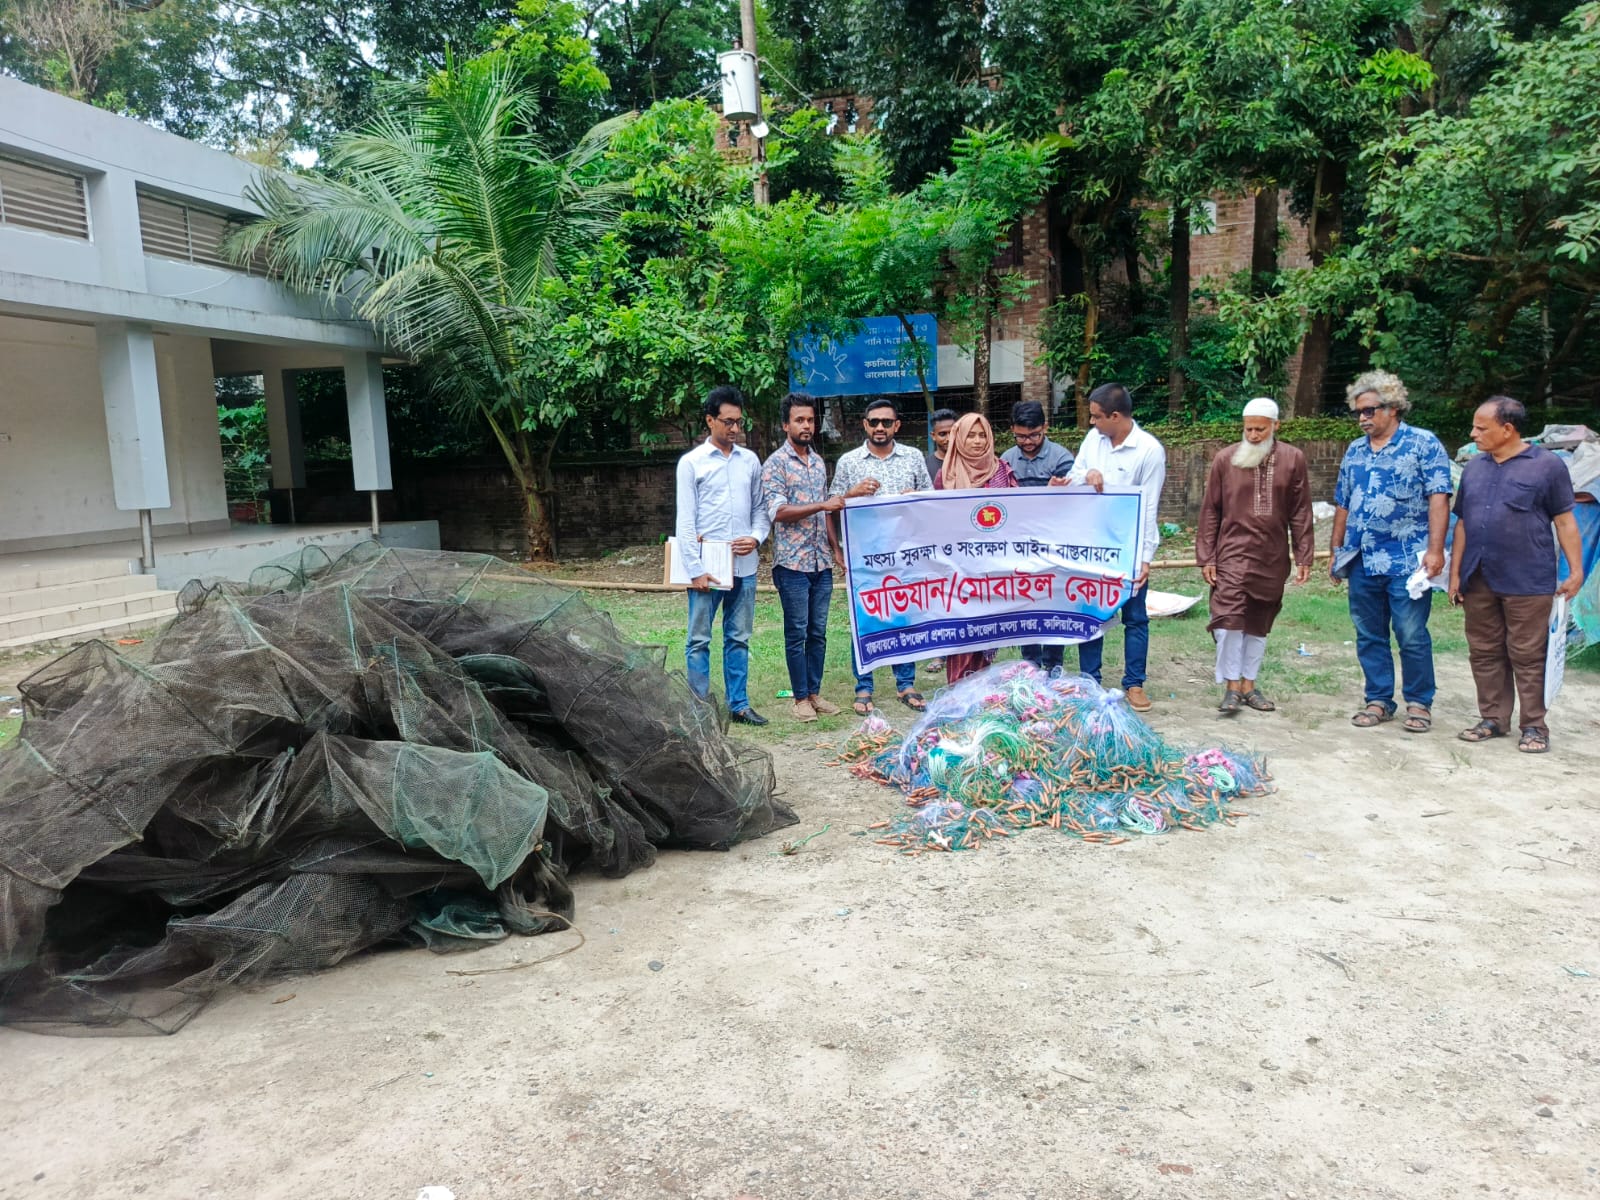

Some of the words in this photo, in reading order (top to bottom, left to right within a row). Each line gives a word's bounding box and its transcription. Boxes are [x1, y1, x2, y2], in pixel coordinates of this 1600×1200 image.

[864, 370, 906, 379] ভালোভাবে
[863, 552, 896, 568] মৎস্য
[900, 544, 937, 566] সুরক্ষা
[941, 543, 953, 556] ও
[957, 540, 1009, 557] সংরক্ষণ
[1012, 538, 1050, 557] আইন
[1055, 544, 1122, 564] বাস্তবায়নে
[1065, 573, 1126, 608] কোর্ট
[899, 631, 929, 648] উপজেলা
[930, 627, 957, 641] প্রশাসন
[958, 627, 966, 639] ও
[967, 622, 998, 638] উপজেলা
